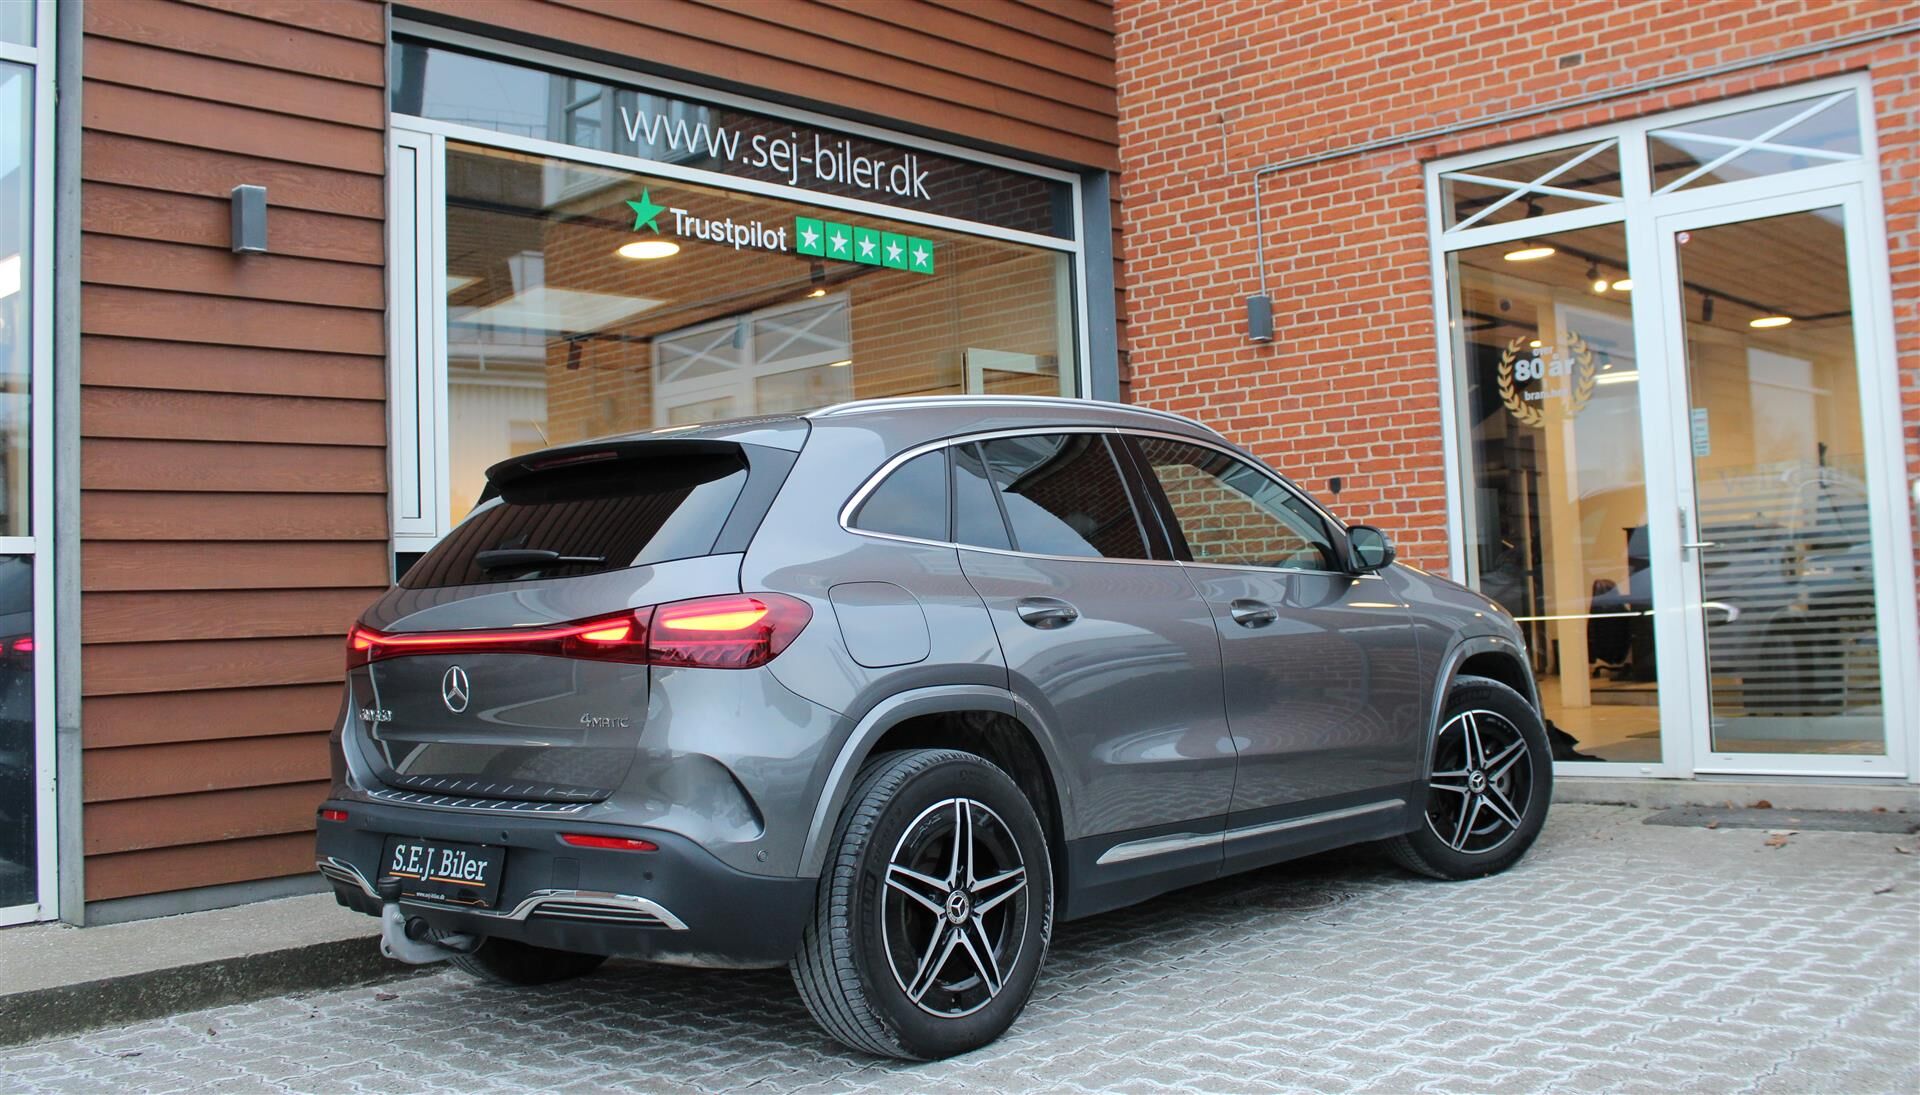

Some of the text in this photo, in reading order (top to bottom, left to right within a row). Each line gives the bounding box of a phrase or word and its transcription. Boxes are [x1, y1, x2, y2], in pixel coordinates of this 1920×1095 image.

[620, 106, 931, 200] www.sej-biler.dk
[669, 207, 788, 251] Trustpilot
[1514, 353, 1575, 381] 80 år
[580, 712, 630, 728] 4MATIC
[392, 844, 488, 881] S.E.J. Biler
